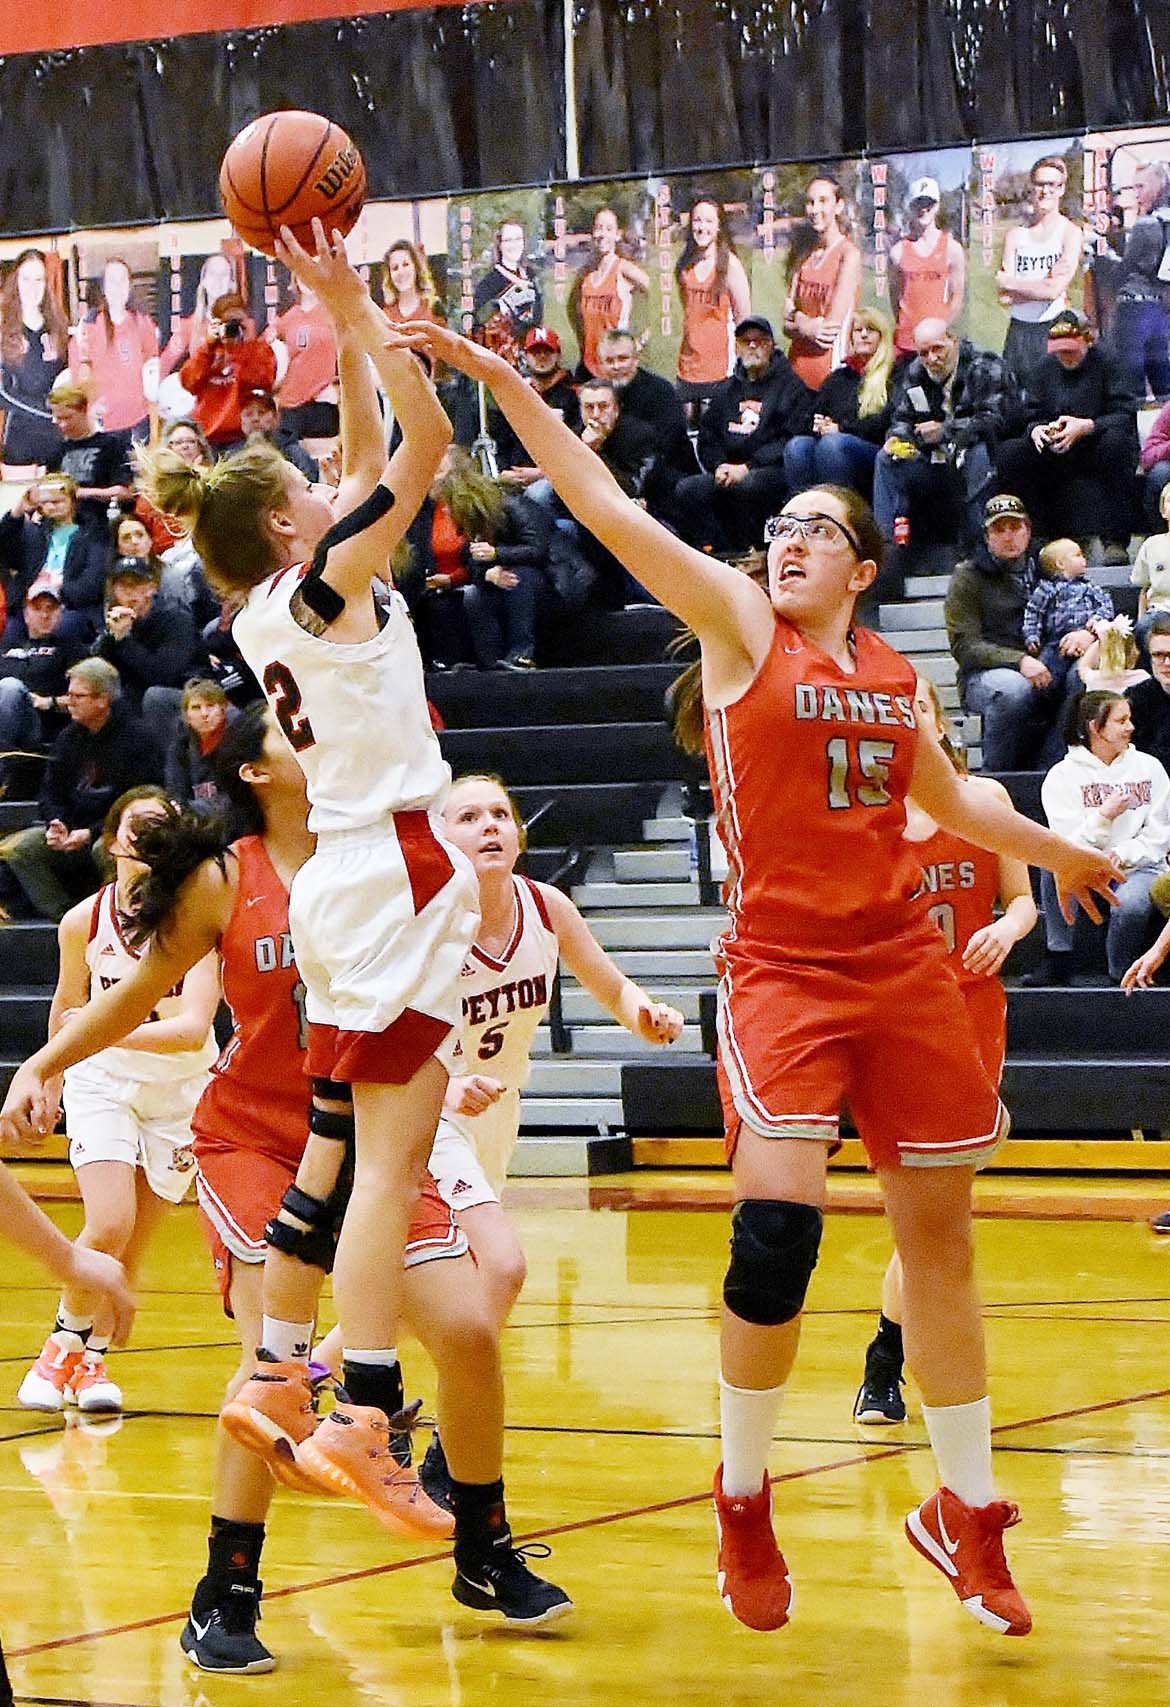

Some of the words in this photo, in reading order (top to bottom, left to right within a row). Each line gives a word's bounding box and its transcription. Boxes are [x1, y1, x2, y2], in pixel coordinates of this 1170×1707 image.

[535, 328, 547, 340] N
[263, 660, 317, 752] 2
[795, 683, 917, 730] DANES
[827, 736, 896, 809] 15
[477, 1021, 510, 1060] 5
